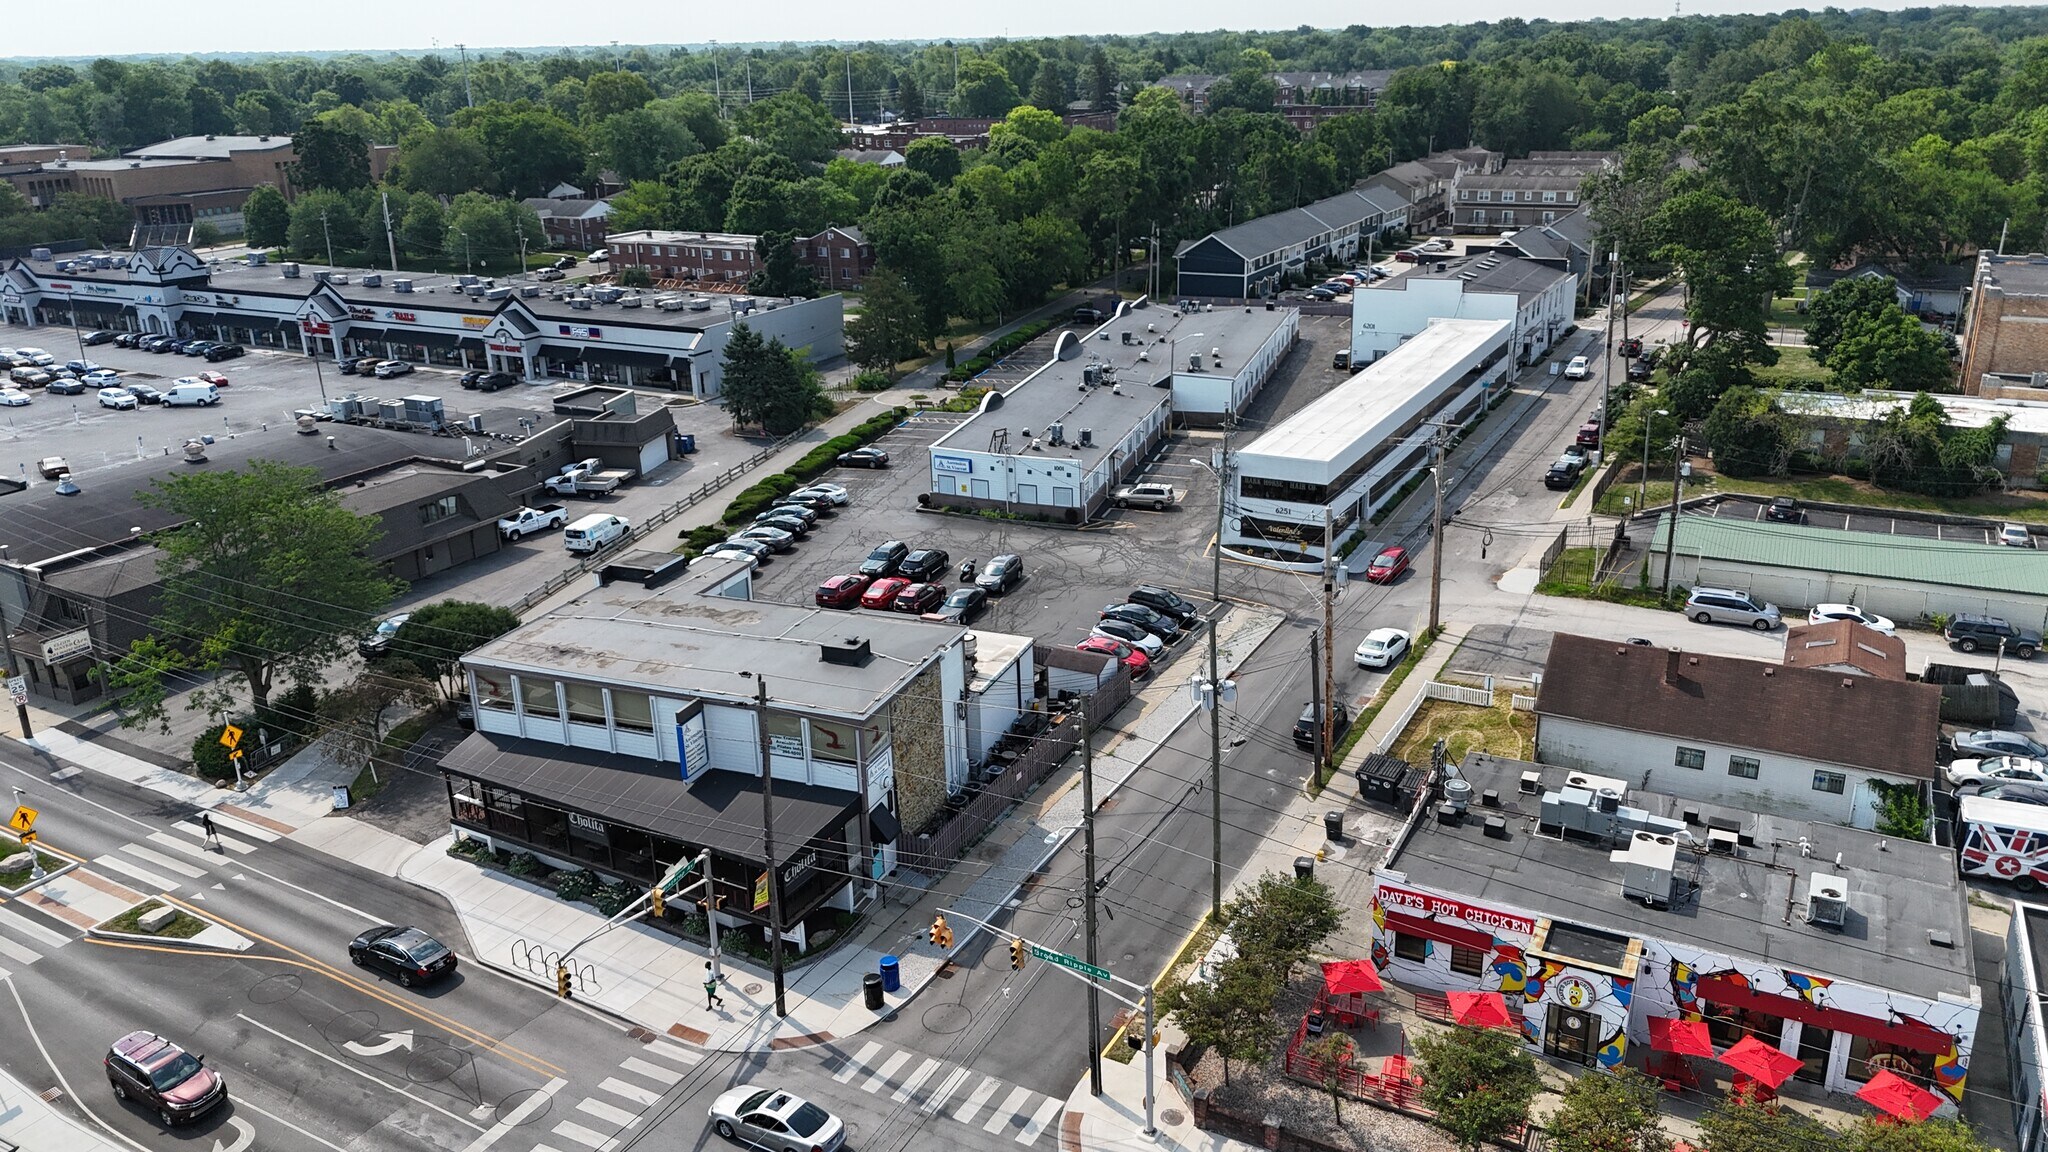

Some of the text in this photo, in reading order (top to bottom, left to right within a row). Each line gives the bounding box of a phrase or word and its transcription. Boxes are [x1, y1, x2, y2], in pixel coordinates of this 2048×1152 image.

[1275, 507, 1291, 515] 6251
[12, 684, 25, 693] 25
[568, 812, 604, 832] Cholita
[784, 852, 816, 882] Cholita
[1379, 889, 1531, 933] DAVE'S HOT CHICKEN
[1034, 949, 1059, 963] Broad
[1064, 959, 1092, 972] Ripple
[1096, 970, 1108, 978] Av
